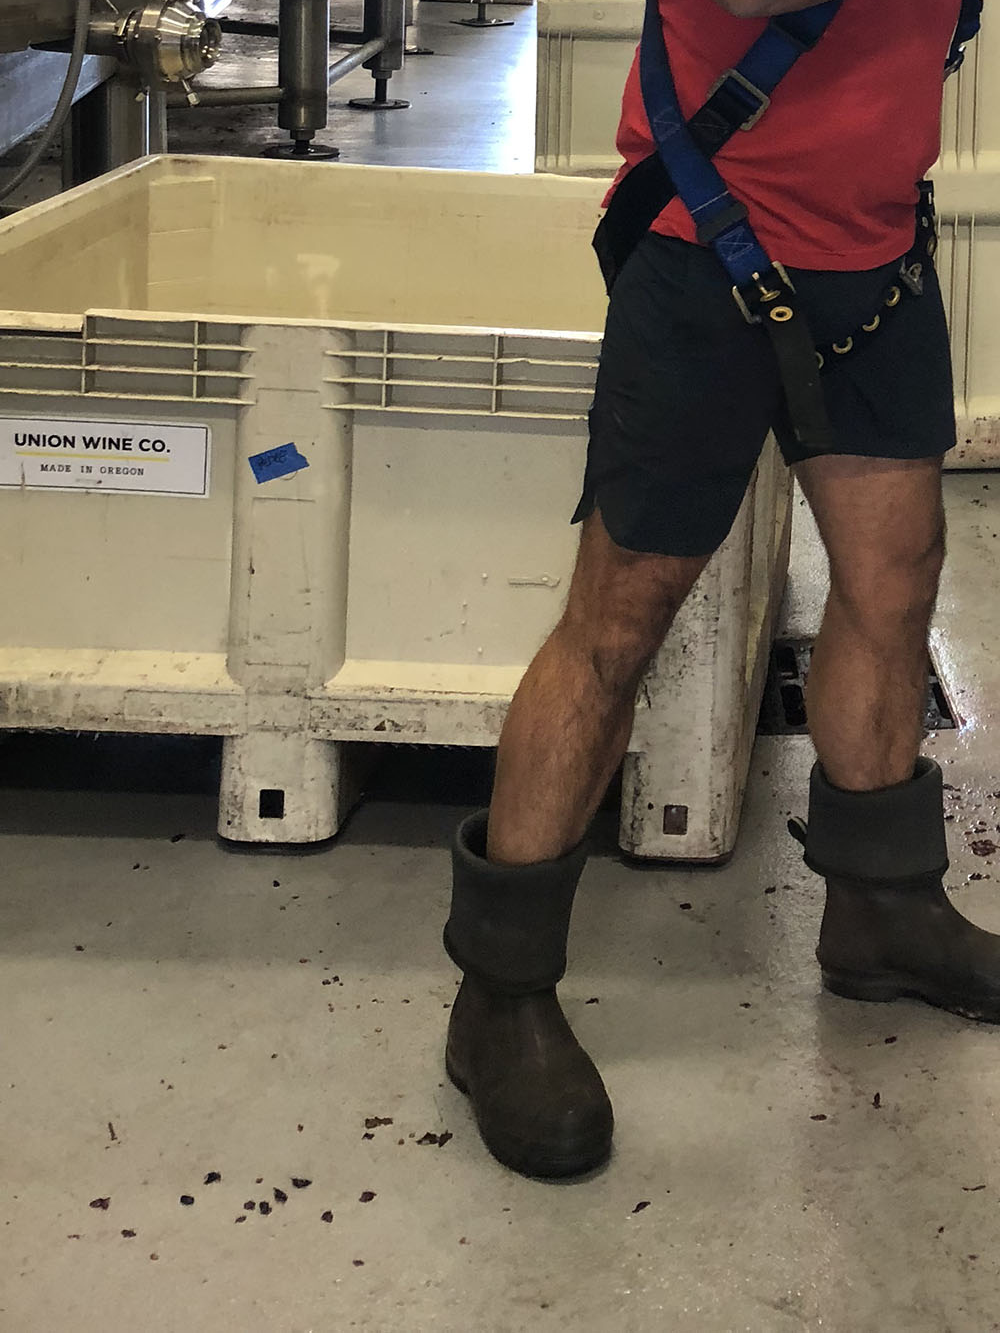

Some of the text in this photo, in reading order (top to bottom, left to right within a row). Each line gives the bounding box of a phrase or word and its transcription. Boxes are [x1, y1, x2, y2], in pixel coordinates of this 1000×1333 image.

[14, 433, 171, 454] UNION WINE CO.
[40, 463, 145, 477] MADE IN OREGON
